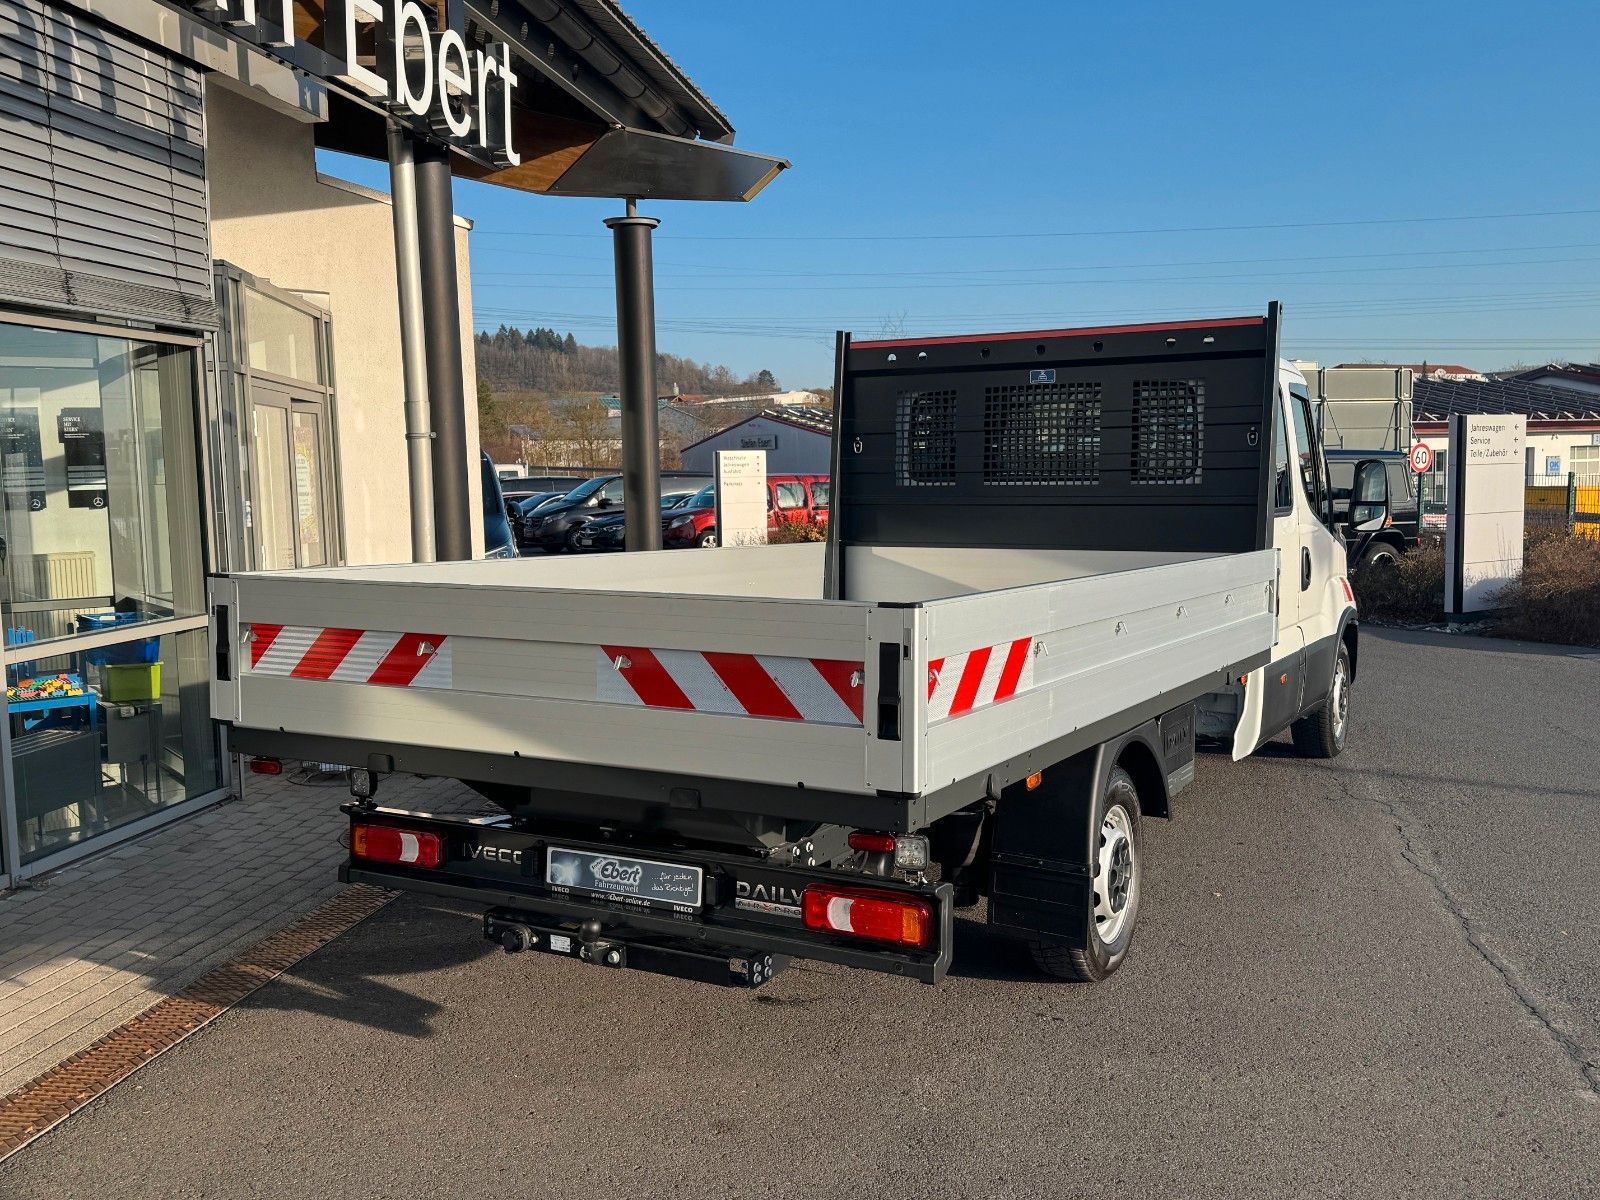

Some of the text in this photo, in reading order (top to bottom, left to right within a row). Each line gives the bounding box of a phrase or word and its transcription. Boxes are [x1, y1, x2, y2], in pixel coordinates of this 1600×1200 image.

[1470, 424, 1506, 433] Jahreswagen
[1470, 436, 1491, 445] Service
[1415, 451, 1427, 465] 60
[1470, 449, 1508, 458] Teile/Zubehör
[600, 860, 641, 883] Ebert
[551, 885, 570, 894] IVECO
[594, 879, 639, 893] Fahrzeugwelt
[651, 883, 664, 891] das
[736, 880, 803, 905] DAILY
[673, 904, 694, 914] IVECO
